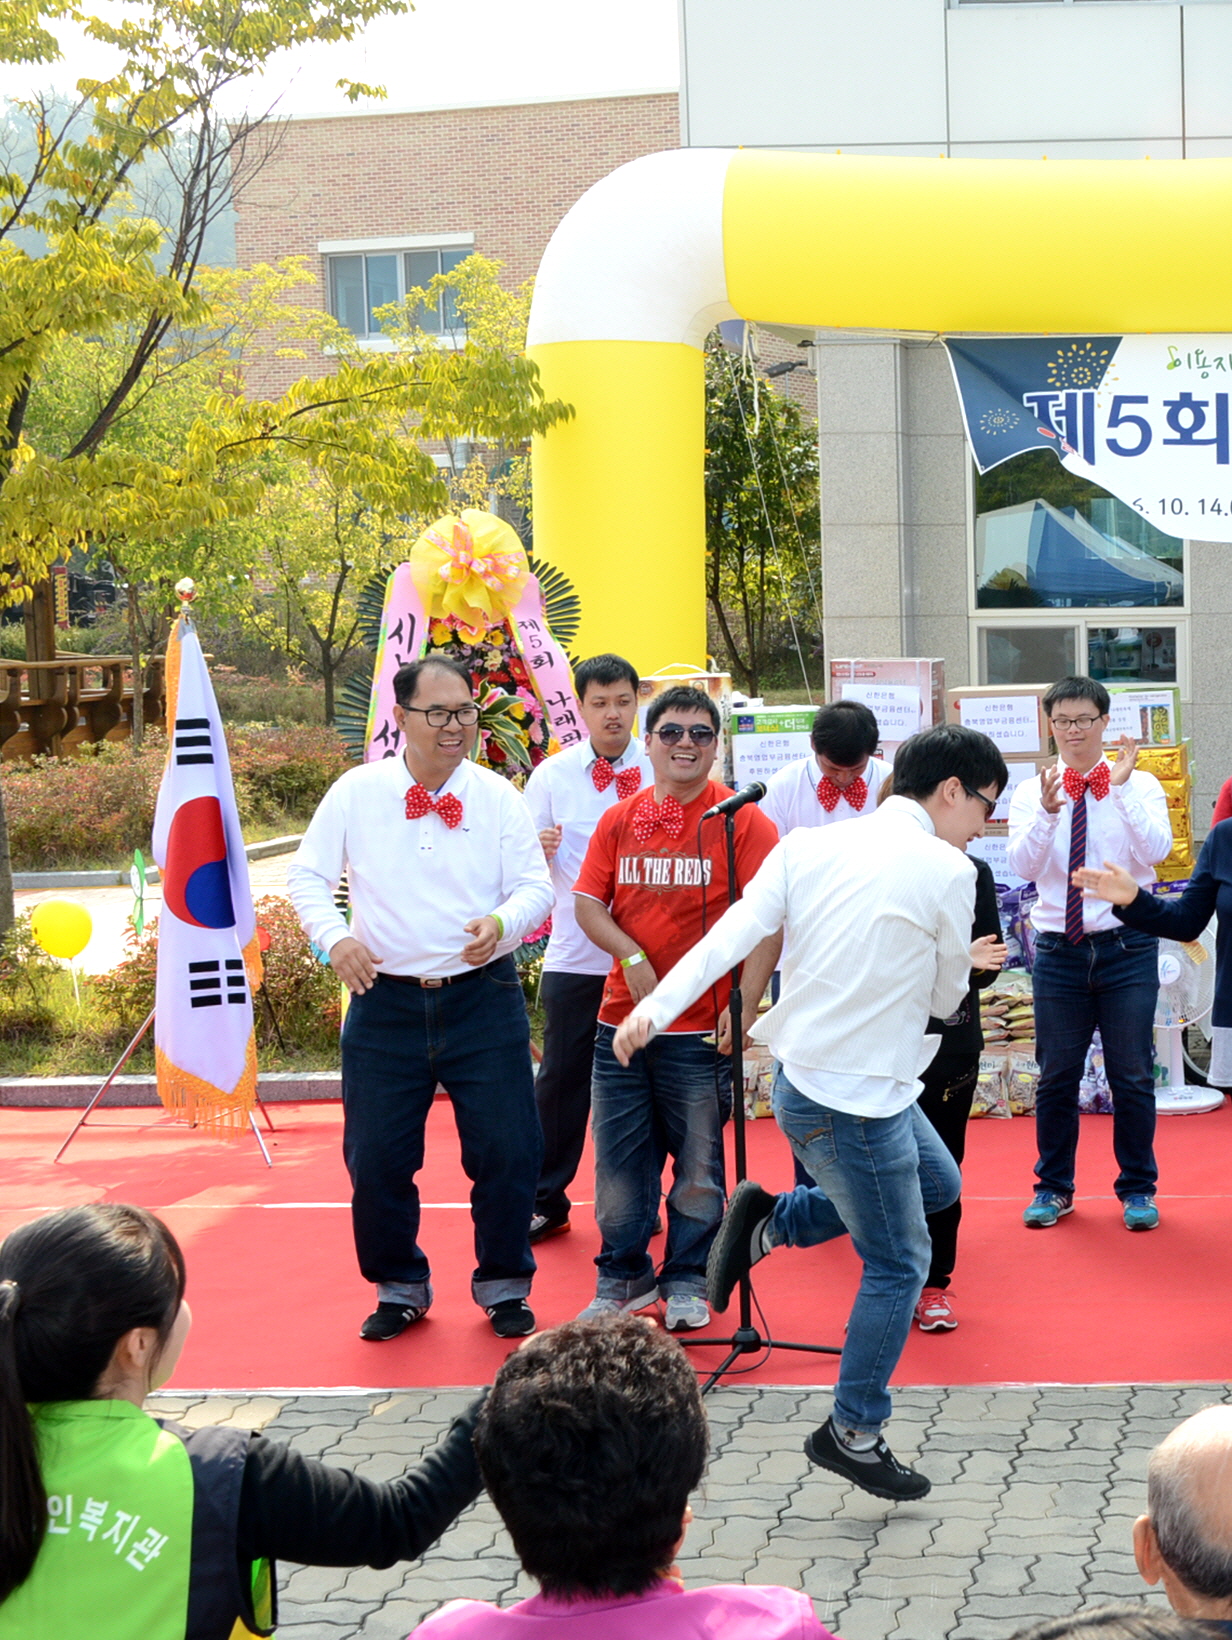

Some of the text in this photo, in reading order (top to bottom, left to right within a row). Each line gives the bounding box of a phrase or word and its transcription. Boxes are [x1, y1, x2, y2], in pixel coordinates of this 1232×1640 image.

[1024, 390, 1230, 467] 제5회
[1158, 498, 1189, 516] 10.
[617, 857, 712, 886] ALL THE REDS
[46, 1494, 169, 1572] 인복지관
